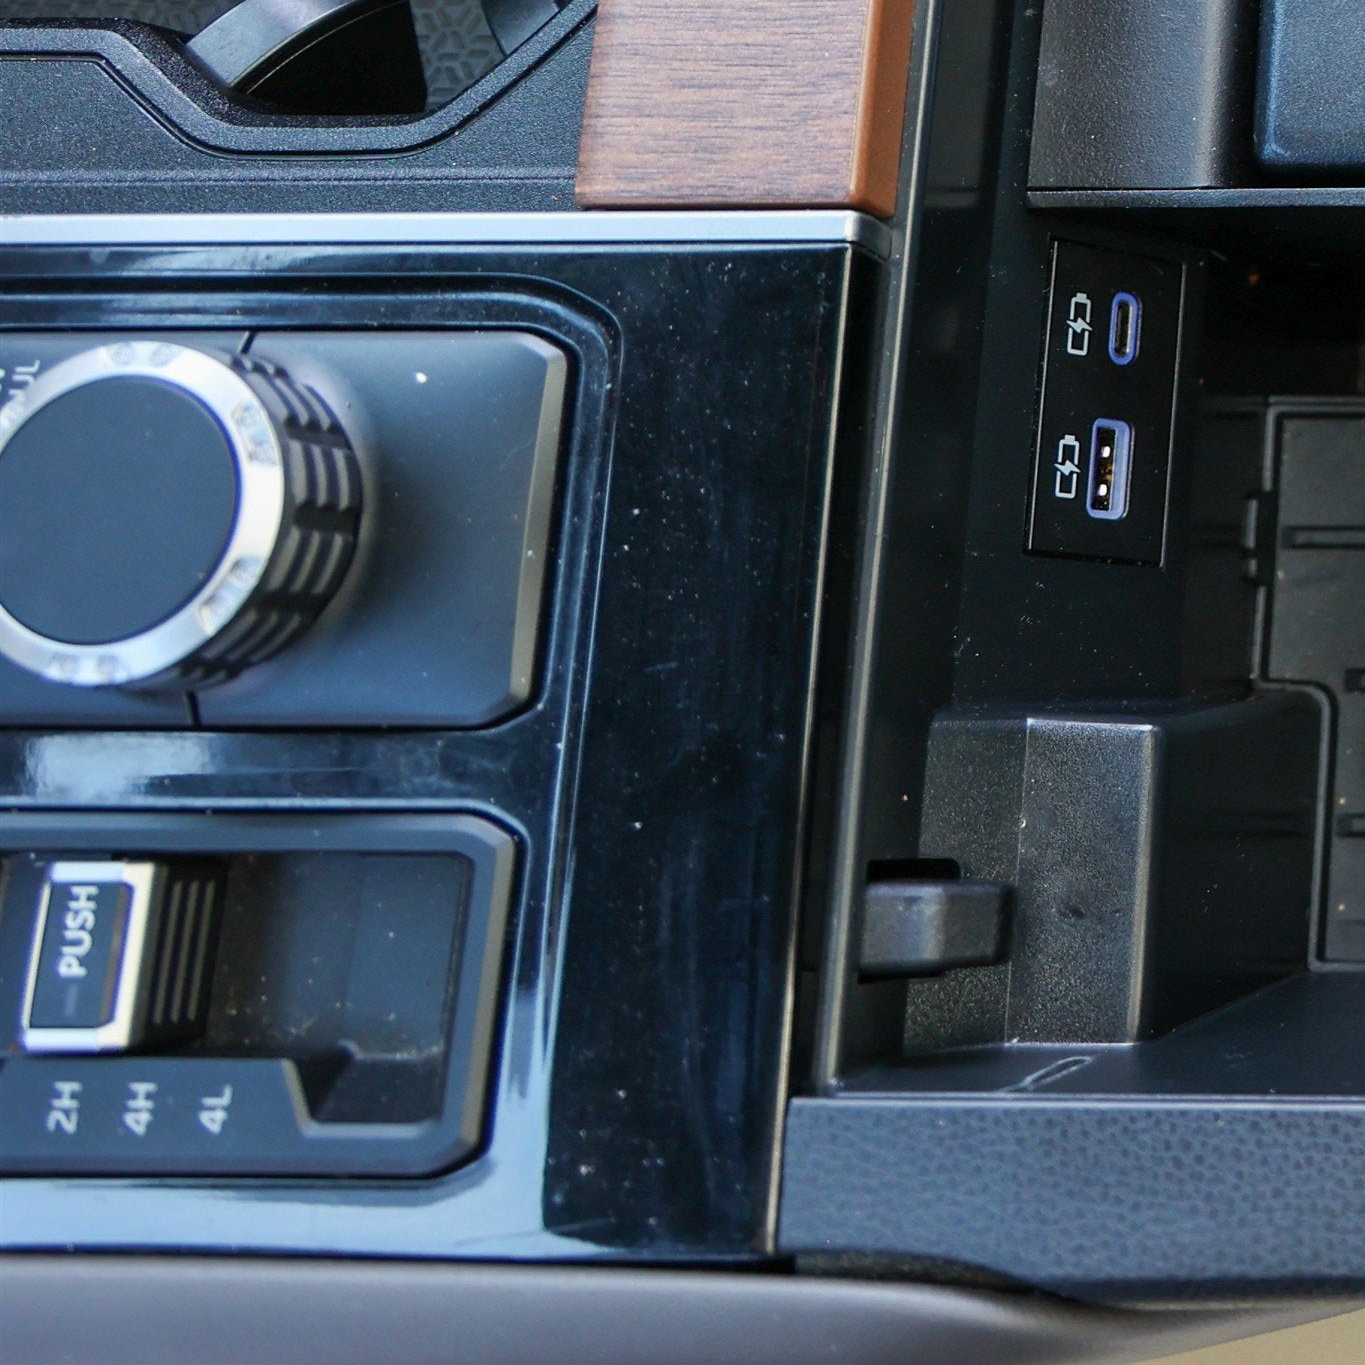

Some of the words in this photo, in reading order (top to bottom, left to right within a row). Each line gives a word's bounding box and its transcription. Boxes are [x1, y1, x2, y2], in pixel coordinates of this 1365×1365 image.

[57, 885, 99, 978] PUSH
[47, 1082, 83, 1134] 2H
[122, 1082, 158, 1134] 4H
[200, 1084, 233, 1134] 4L
